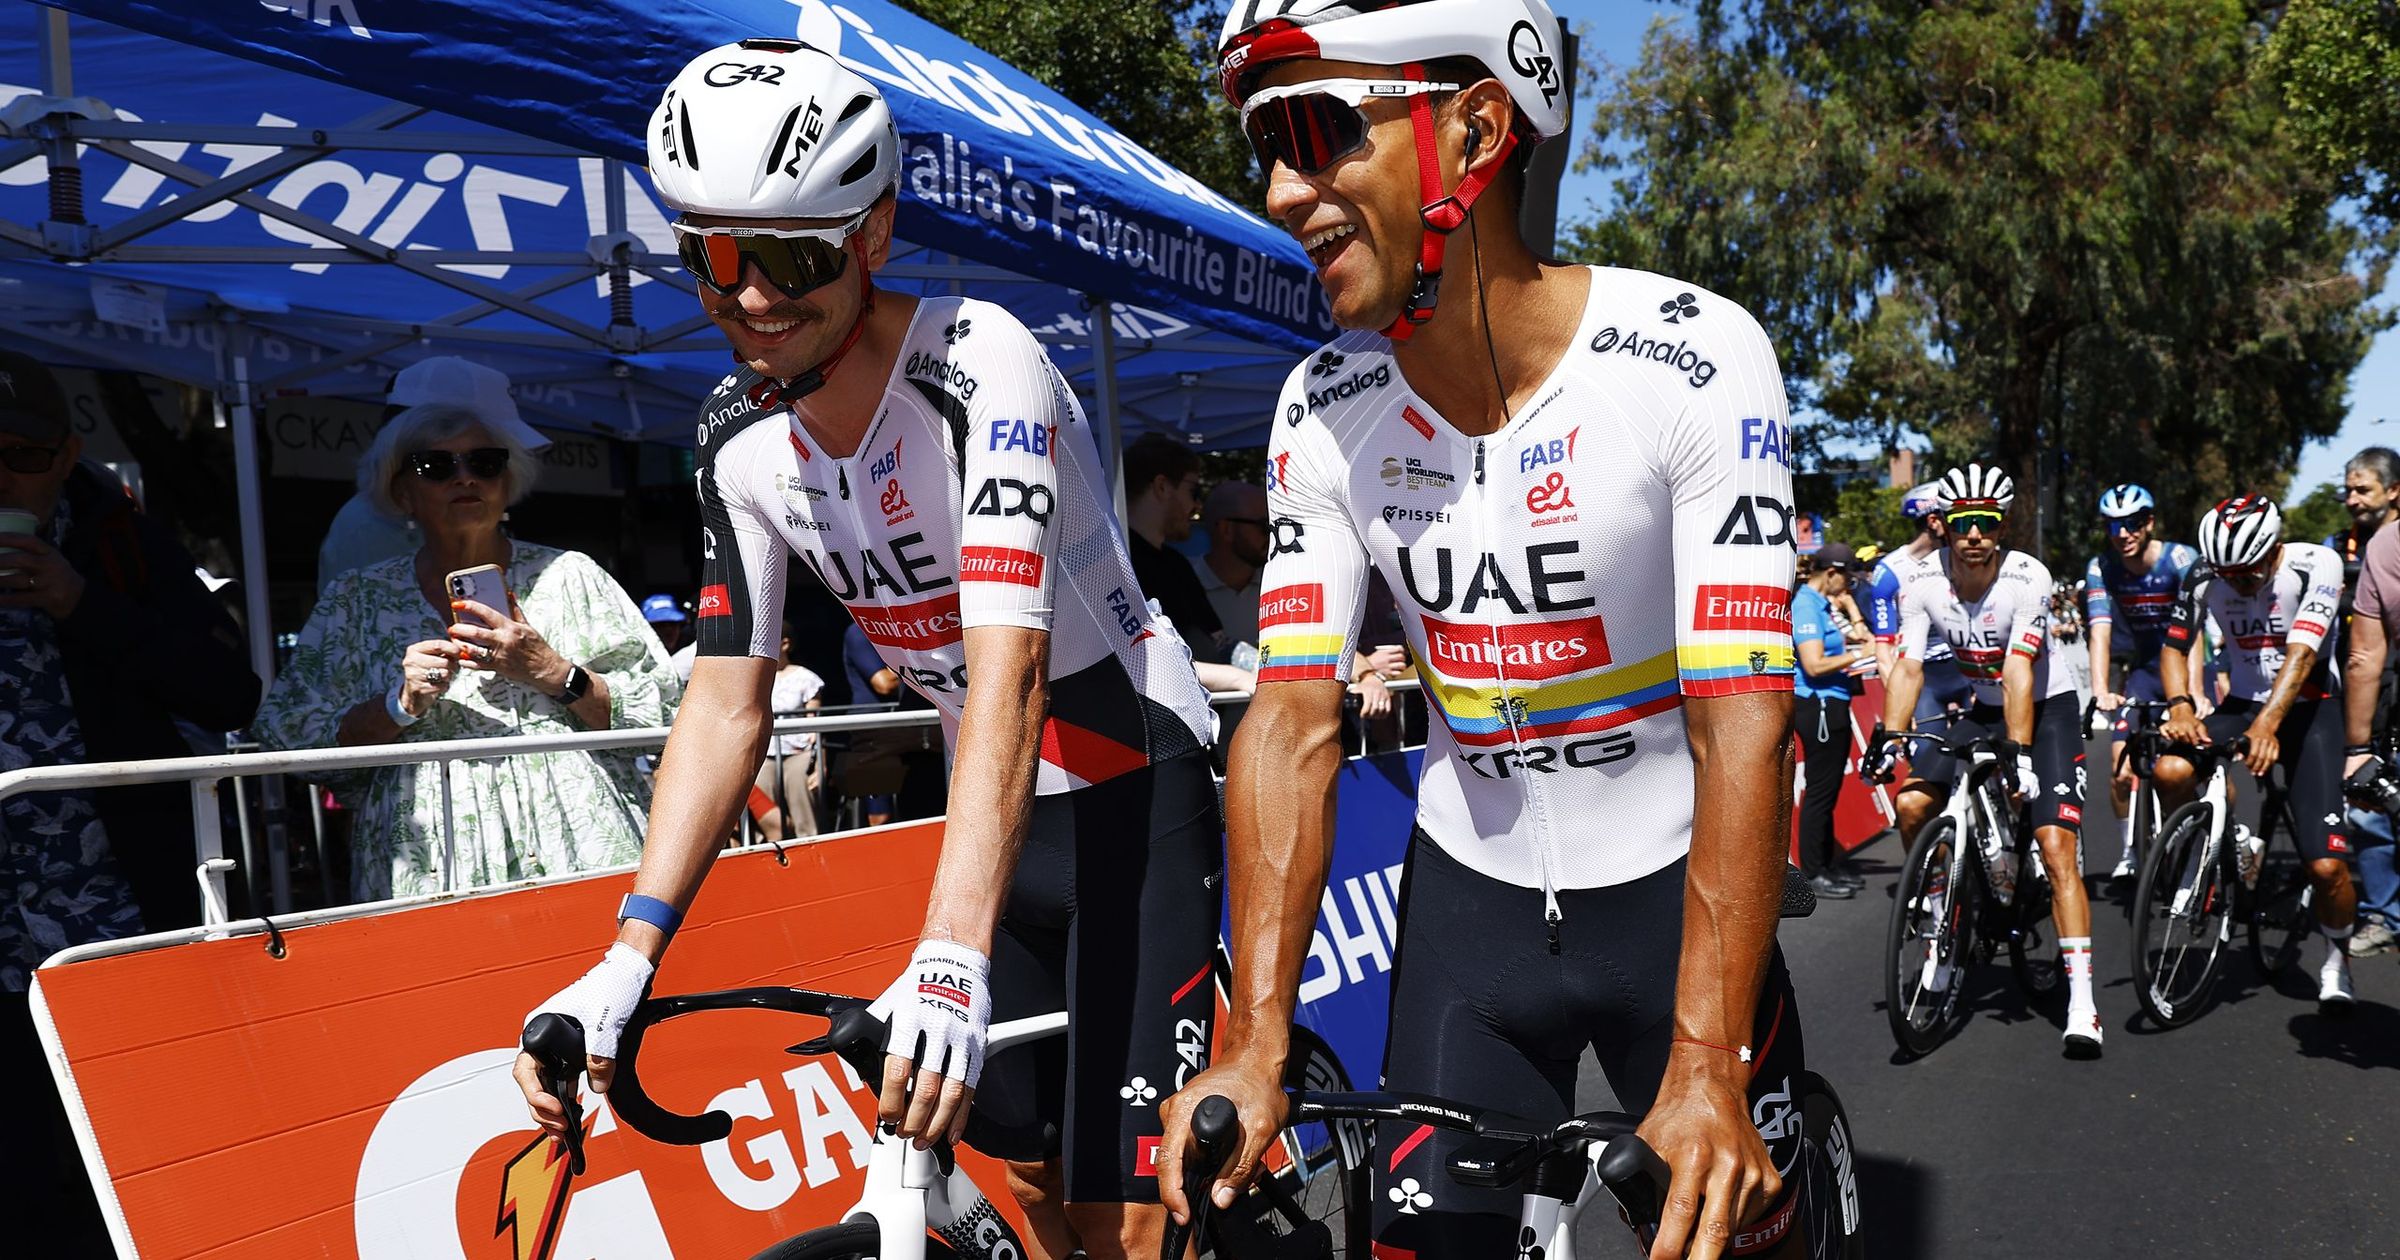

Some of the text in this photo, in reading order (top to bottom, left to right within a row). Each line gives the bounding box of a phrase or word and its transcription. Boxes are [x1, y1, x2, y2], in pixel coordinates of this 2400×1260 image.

[704, 62, 786, 88] G42
[1220, 44, 1252, 79] MET
[1506, 19, 1560, 109] G42
[661, 89, 682, 169] MET
[783, 95, 824, 180] MET
[900, 133, 1037, 232] alia's
[1049, 176, 1225, 297] Favourite
[1234, 247, 1314, 324] Blind
[1617, 330, 1718, 389] Analog
[919, 353, 979, 400] Analog
[1308, 363, 1390, 416] Analog
[1406, 457, 1421, 467] UCI
[1406, 467, 1455, 482] WORLDTOUR
[787, 484, 829, 497] WORLDTOUR
[1407, 475, 1446, 488] BEST TEAM
[794, 518, 832, 532] PISSEI
[1399, 508, 1450, 524] PISSEI
[1562, 512, 1578, 522] and
[804, 531, 954, 601] UAE
[961, 554, 1035, 578] Emirates
[1397, 540, 1596, 614] UAE
[858, 611, 962, 639] Emirates
[1875, 598, 1889, 630] BOSS
[2230, 617, 2286, 637] UAE
[1433, 631, 1588, 665] Emirates
[1948, 629, 2000, 648] UAE
[1458, 731, 1636, 779] XRG
[1299, 863, 1404, 1005] SHI
[919, 972, 973, 995] UAE
[923, 985, 966, 1003] Emirates
[919, 997, 969, 1023] XRG
[1400, 1103, 1472, 1122] RICHARD MILLE
[700, 1052, 873, 1212] GA
[1458, 1160, 1481, 1169] wahoo
[1735, 1210, 1796, 1249] Emir
